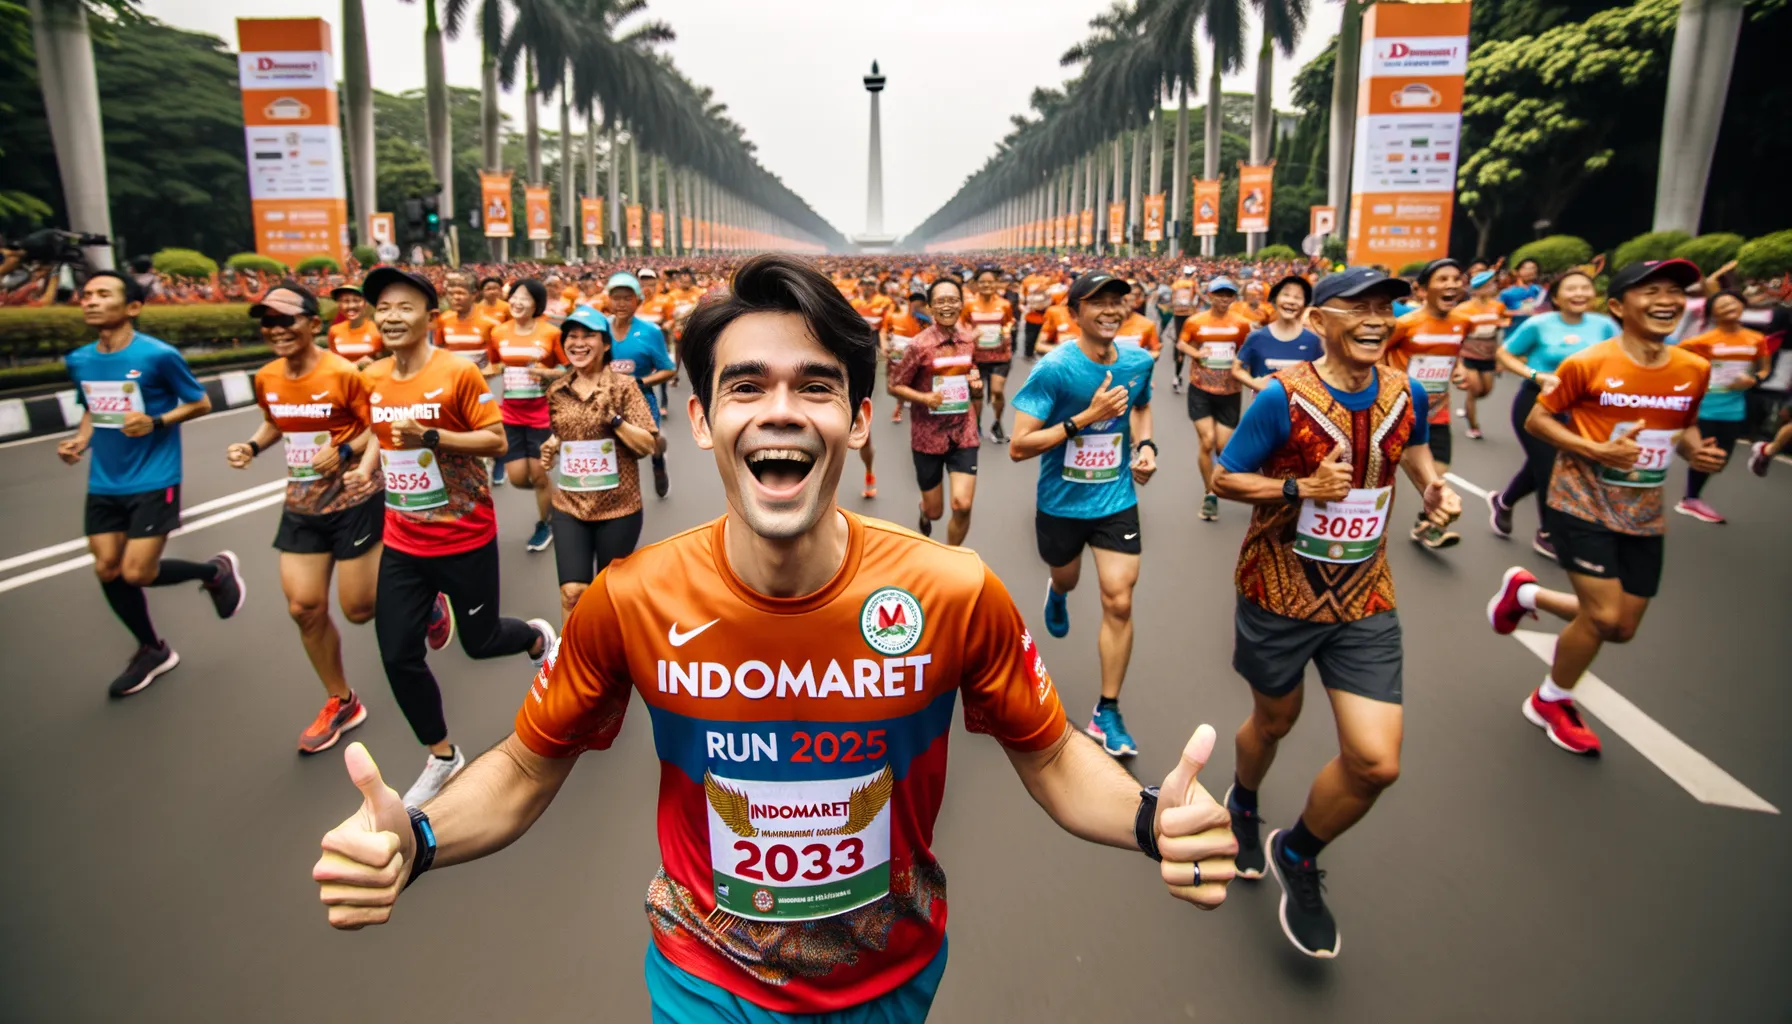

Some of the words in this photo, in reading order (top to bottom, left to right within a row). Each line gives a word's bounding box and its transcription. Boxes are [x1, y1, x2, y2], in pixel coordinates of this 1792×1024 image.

[657, 653, 932, 699] INDOMARET
[706, 730, 778, 763] RUN
[790, 729, 887, 763] 2025
[751, 801, 850, 820] INDOMARET
[733, 837, 865, 883] 2033
